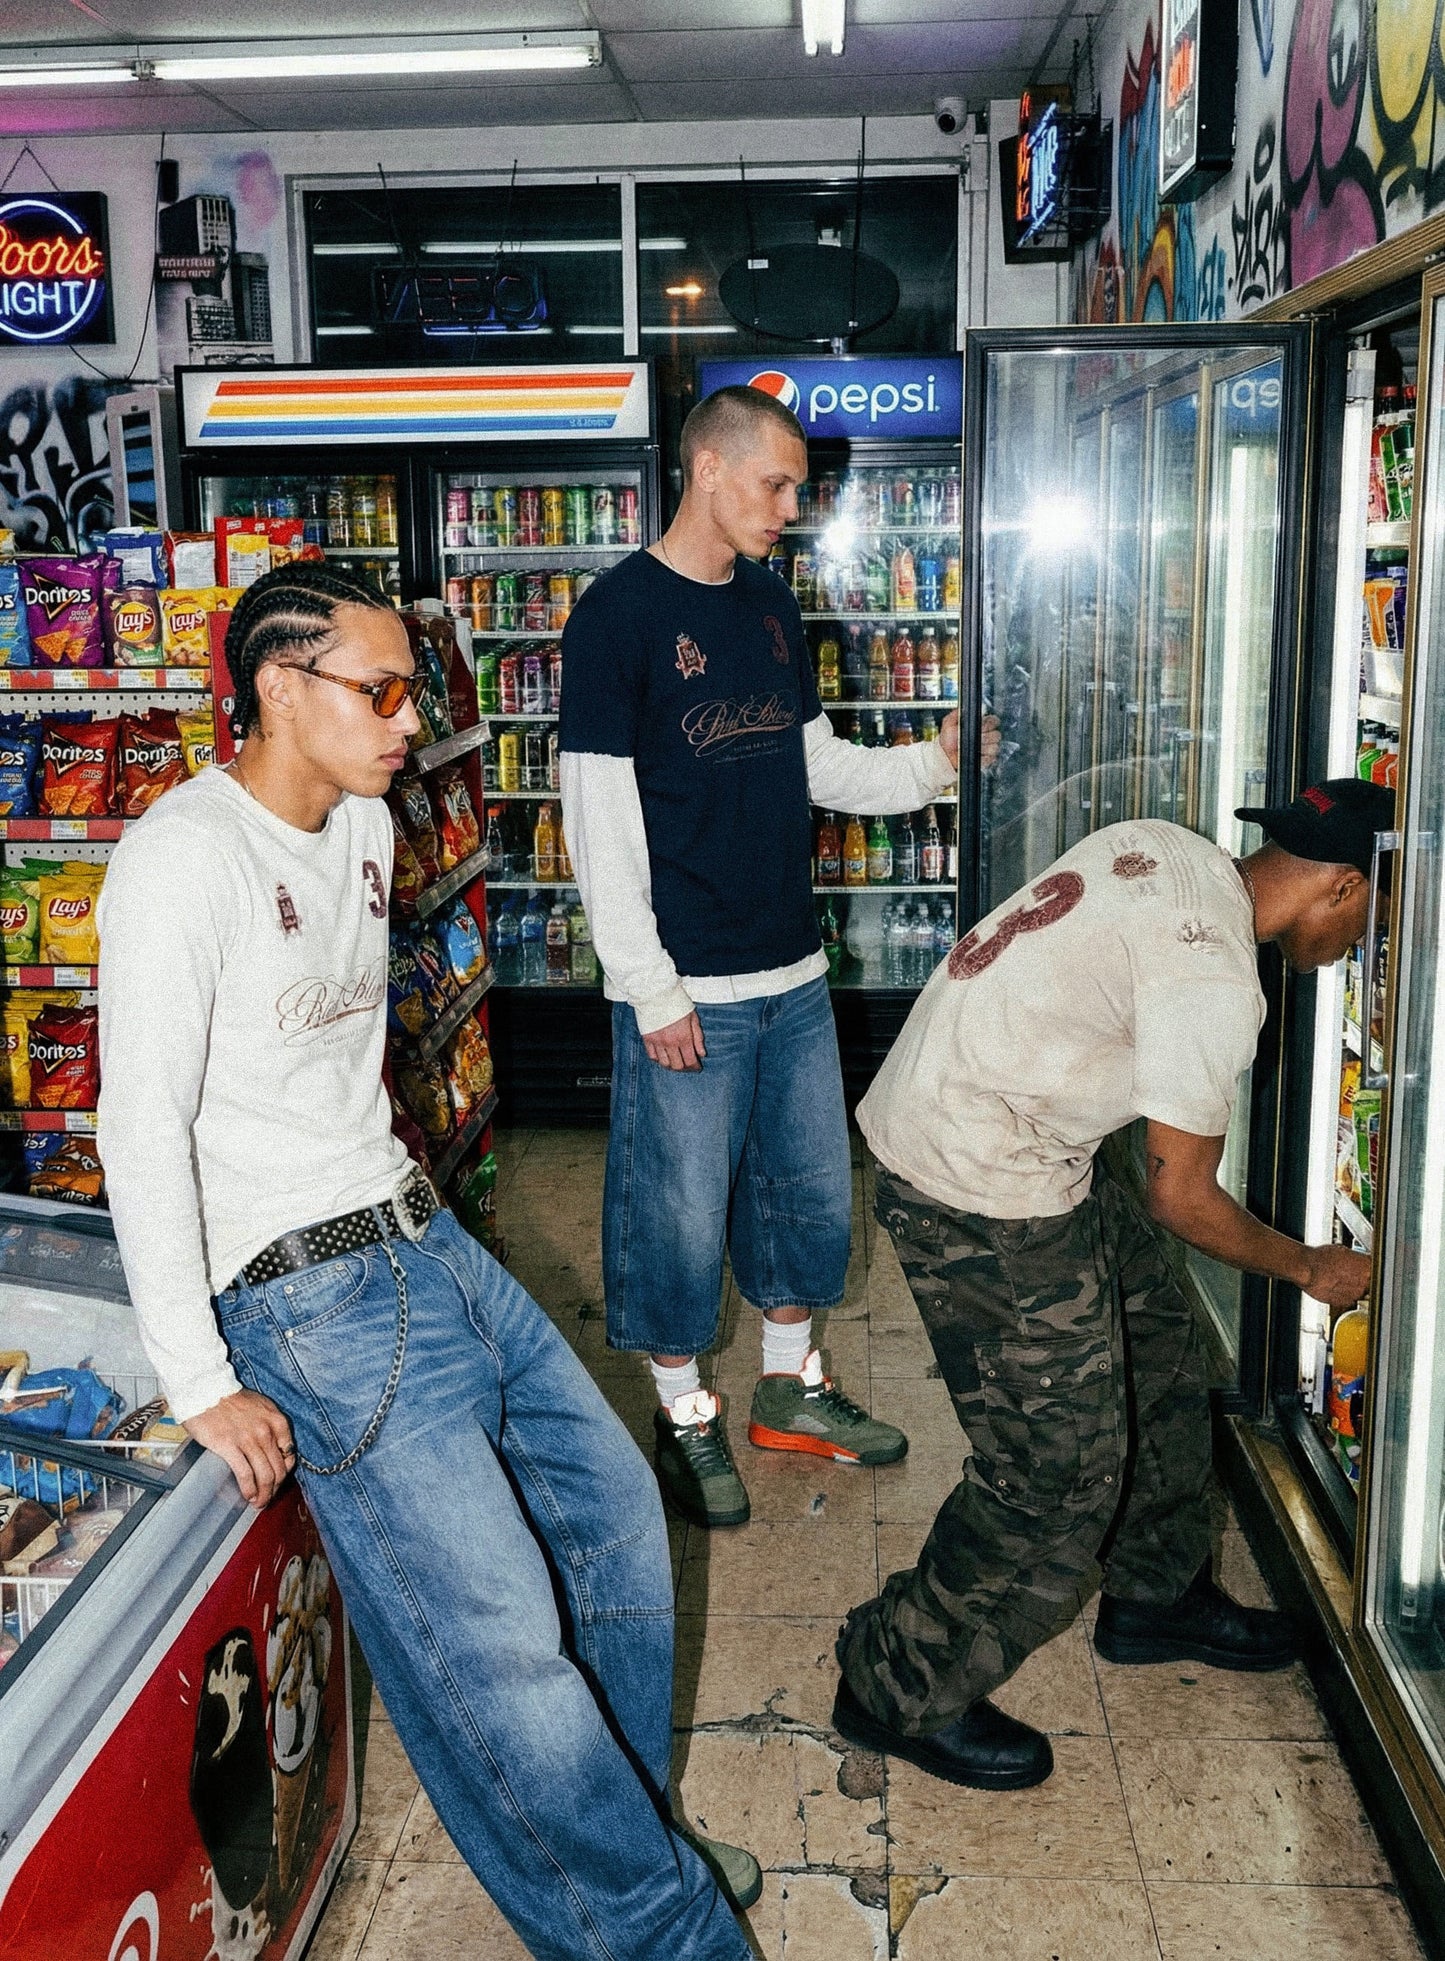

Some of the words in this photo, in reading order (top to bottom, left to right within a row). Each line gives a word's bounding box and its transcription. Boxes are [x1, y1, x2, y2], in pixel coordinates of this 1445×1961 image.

[0, 281, 84, 316] IGHT
[809, 374, 940, 423] pepsi
[0, 594, 14, 609] os
[25, 586, 92, 606] Doritos
[118, 610, 153, 634] Lay's
[763, 615, 790, 665] 3
[0, 751, 24, 766] os
[42, 743, 104, 762] Doritos
[362, 859, 387, 919] 3
[0, 907, 26, 929] ay's
[50, 898, 90, 920] Lay's
[947, 870, 1085, 981] 3
[29, 1043, 86, 1060] Doritos
